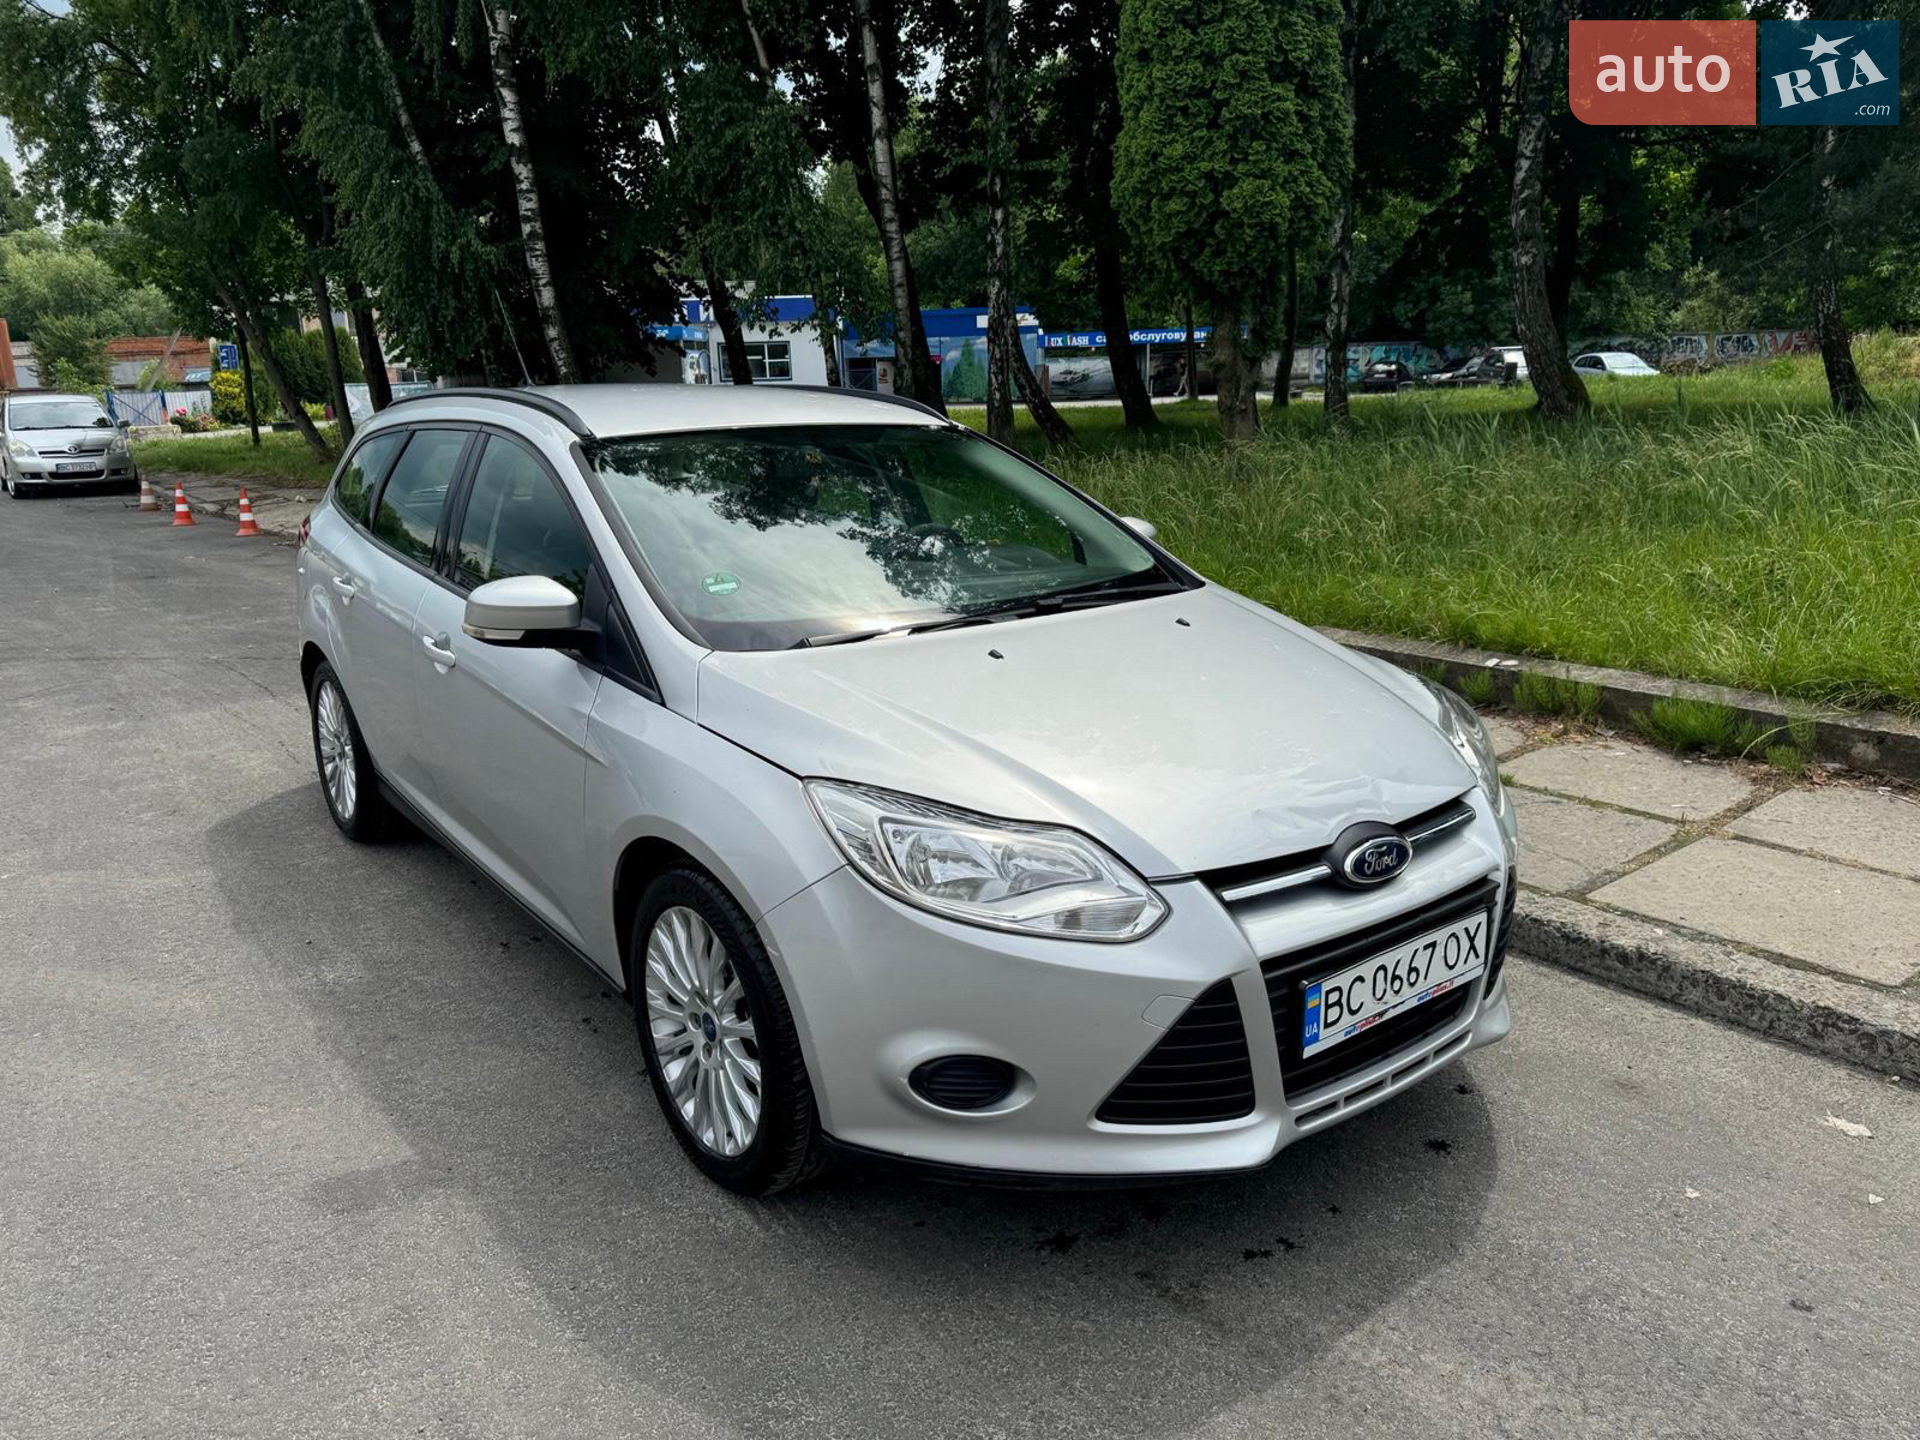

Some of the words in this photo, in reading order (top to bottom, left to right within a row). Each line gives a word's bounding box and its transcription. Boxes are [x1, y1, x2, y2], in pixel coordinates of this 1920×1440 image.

[1364, 845, 1399, 875] Ford
[1372, 940, 1438, 1002] 0667
[1305, 1026, 1319, 1038] UA
